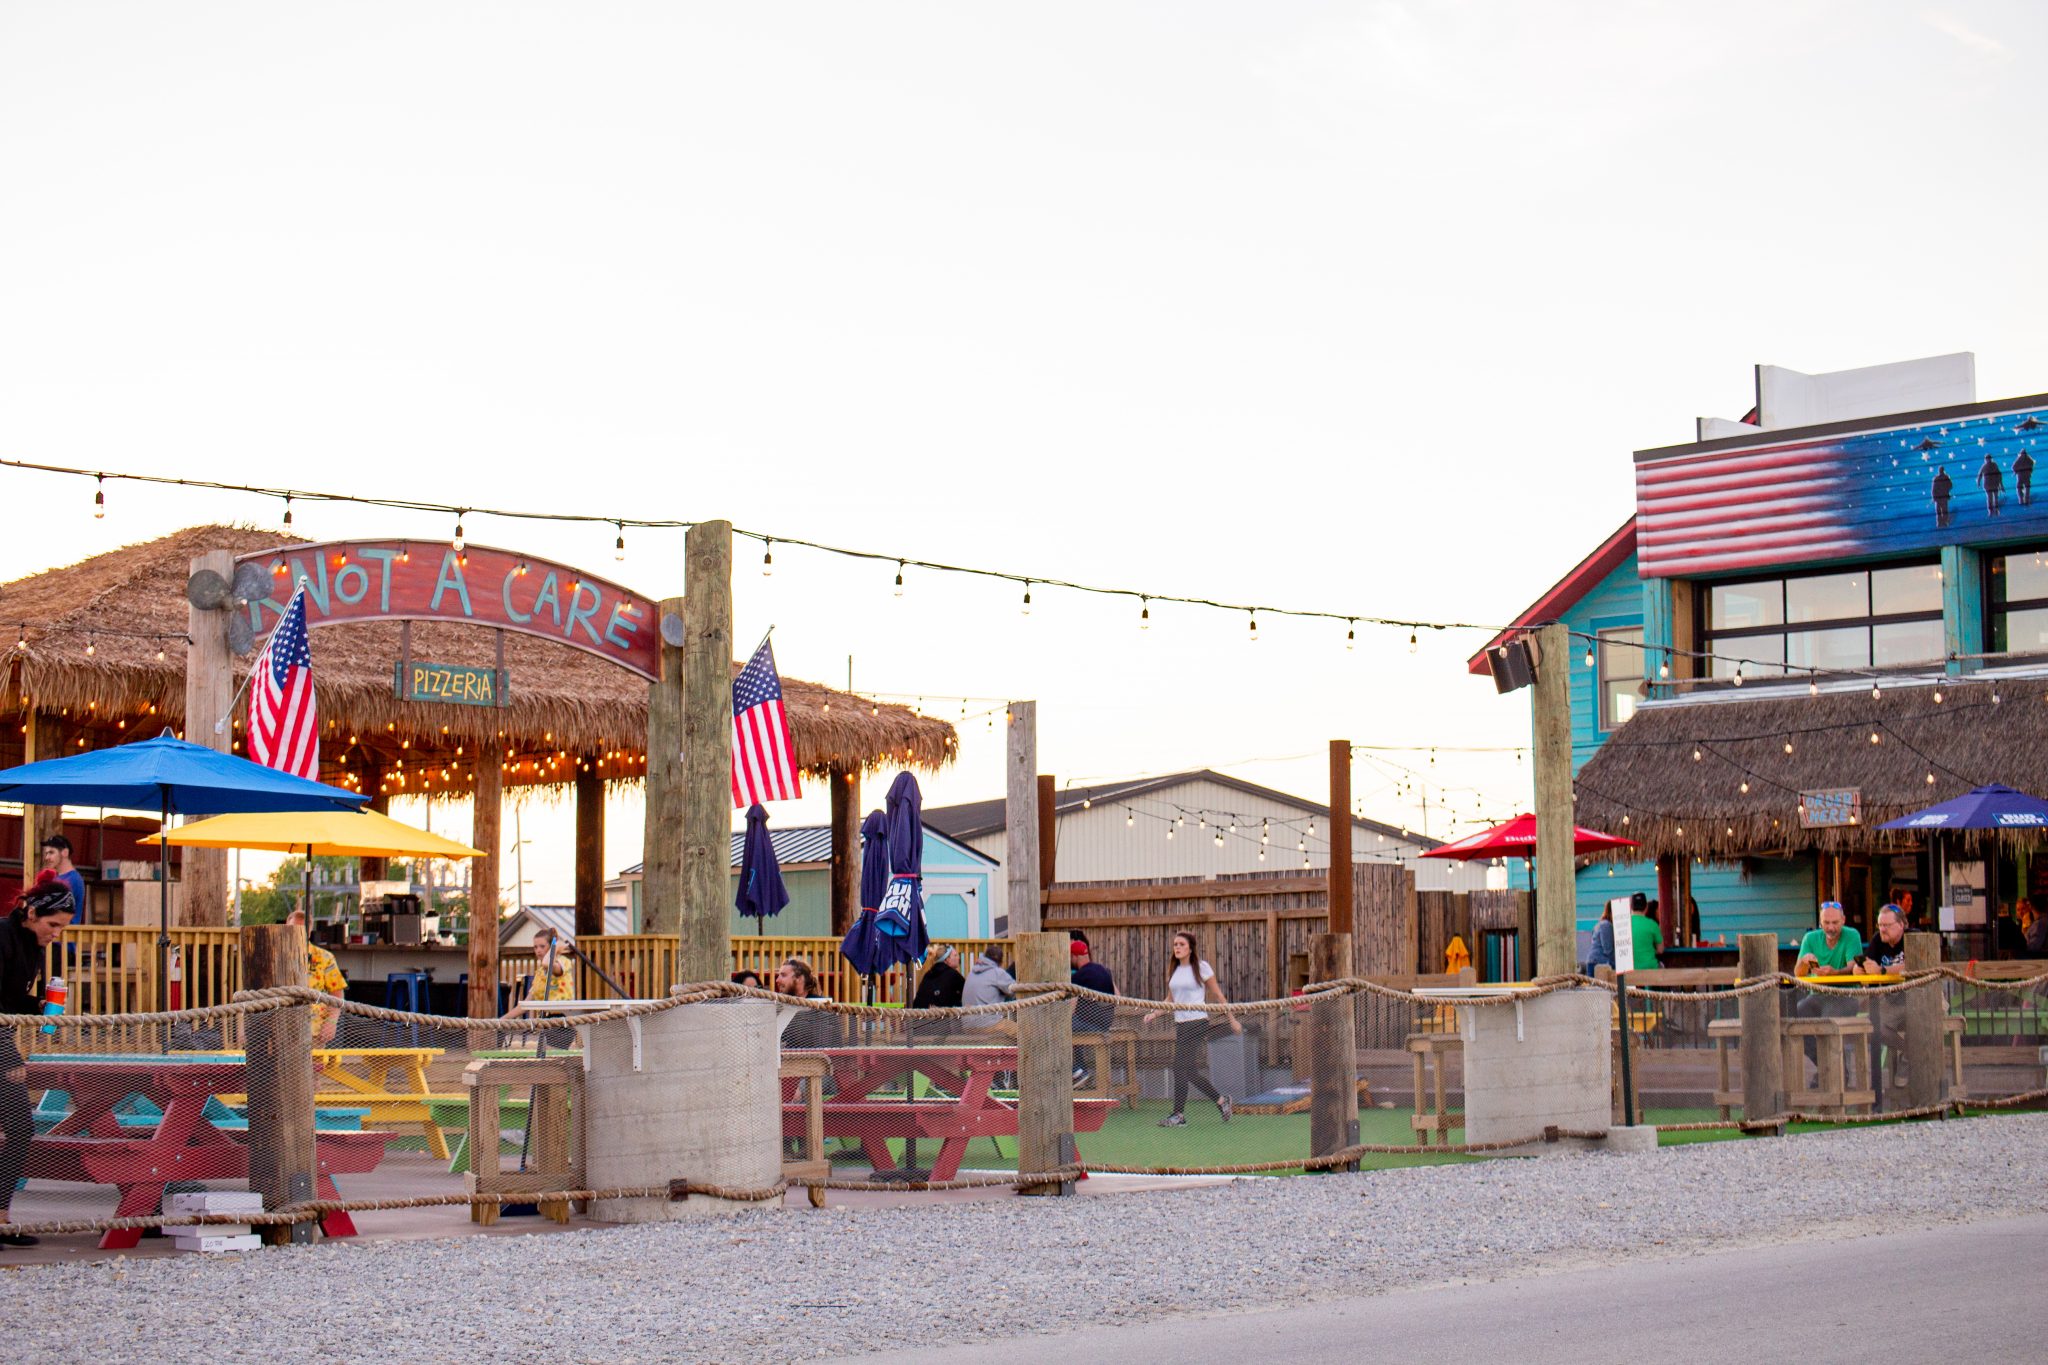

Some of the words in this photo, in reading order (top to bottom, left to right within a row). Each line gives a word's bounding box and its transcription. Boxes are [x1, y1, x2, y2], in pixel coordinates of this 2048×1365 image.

[430, 550, 473, 616] A
[502, 563, 643, 650] CARE
[413, 668, 492, 701] PIZZERIA
[1805, 791, 1853, 810] ORDER
[1809, 809, 1849, 825] HERE
